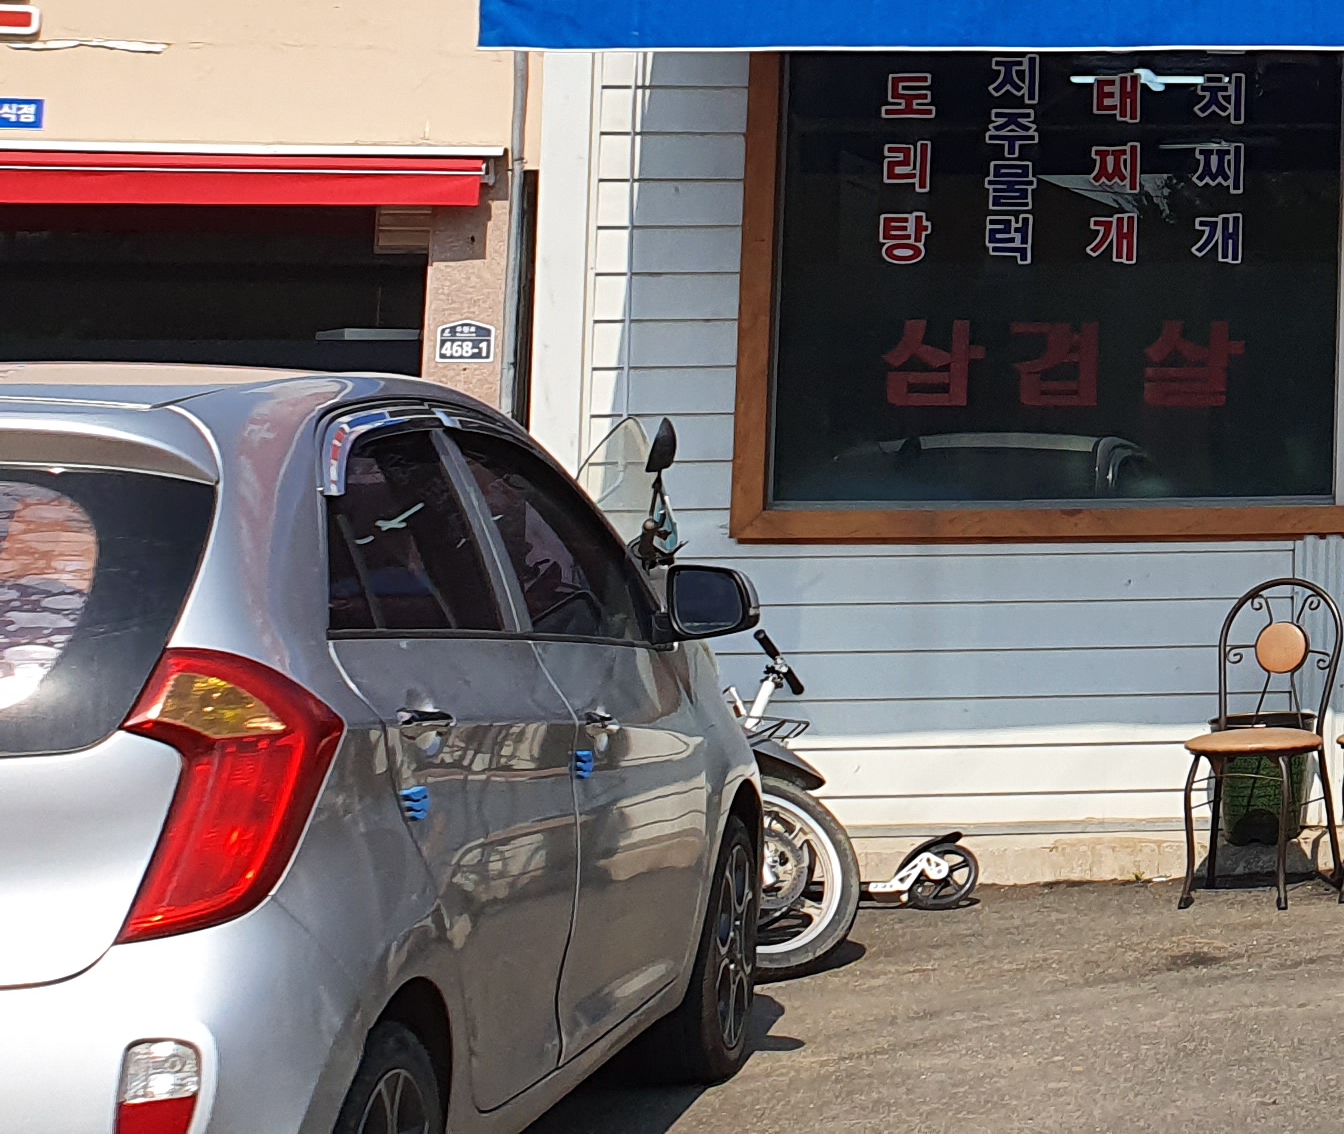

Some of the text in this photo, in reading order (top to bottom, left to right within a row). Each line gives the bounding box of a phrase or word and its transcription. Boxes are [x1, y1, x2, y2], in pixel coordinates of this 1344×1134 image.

[879, 73, 936, 264] 도리탕
[1086, 50, 1142, 264] 태찌개
[1191, 50, 1245, 264] 치찌개
[441, 341, 488, 357] 468-1
[882, 319, 1246, 407] 삼겹살
